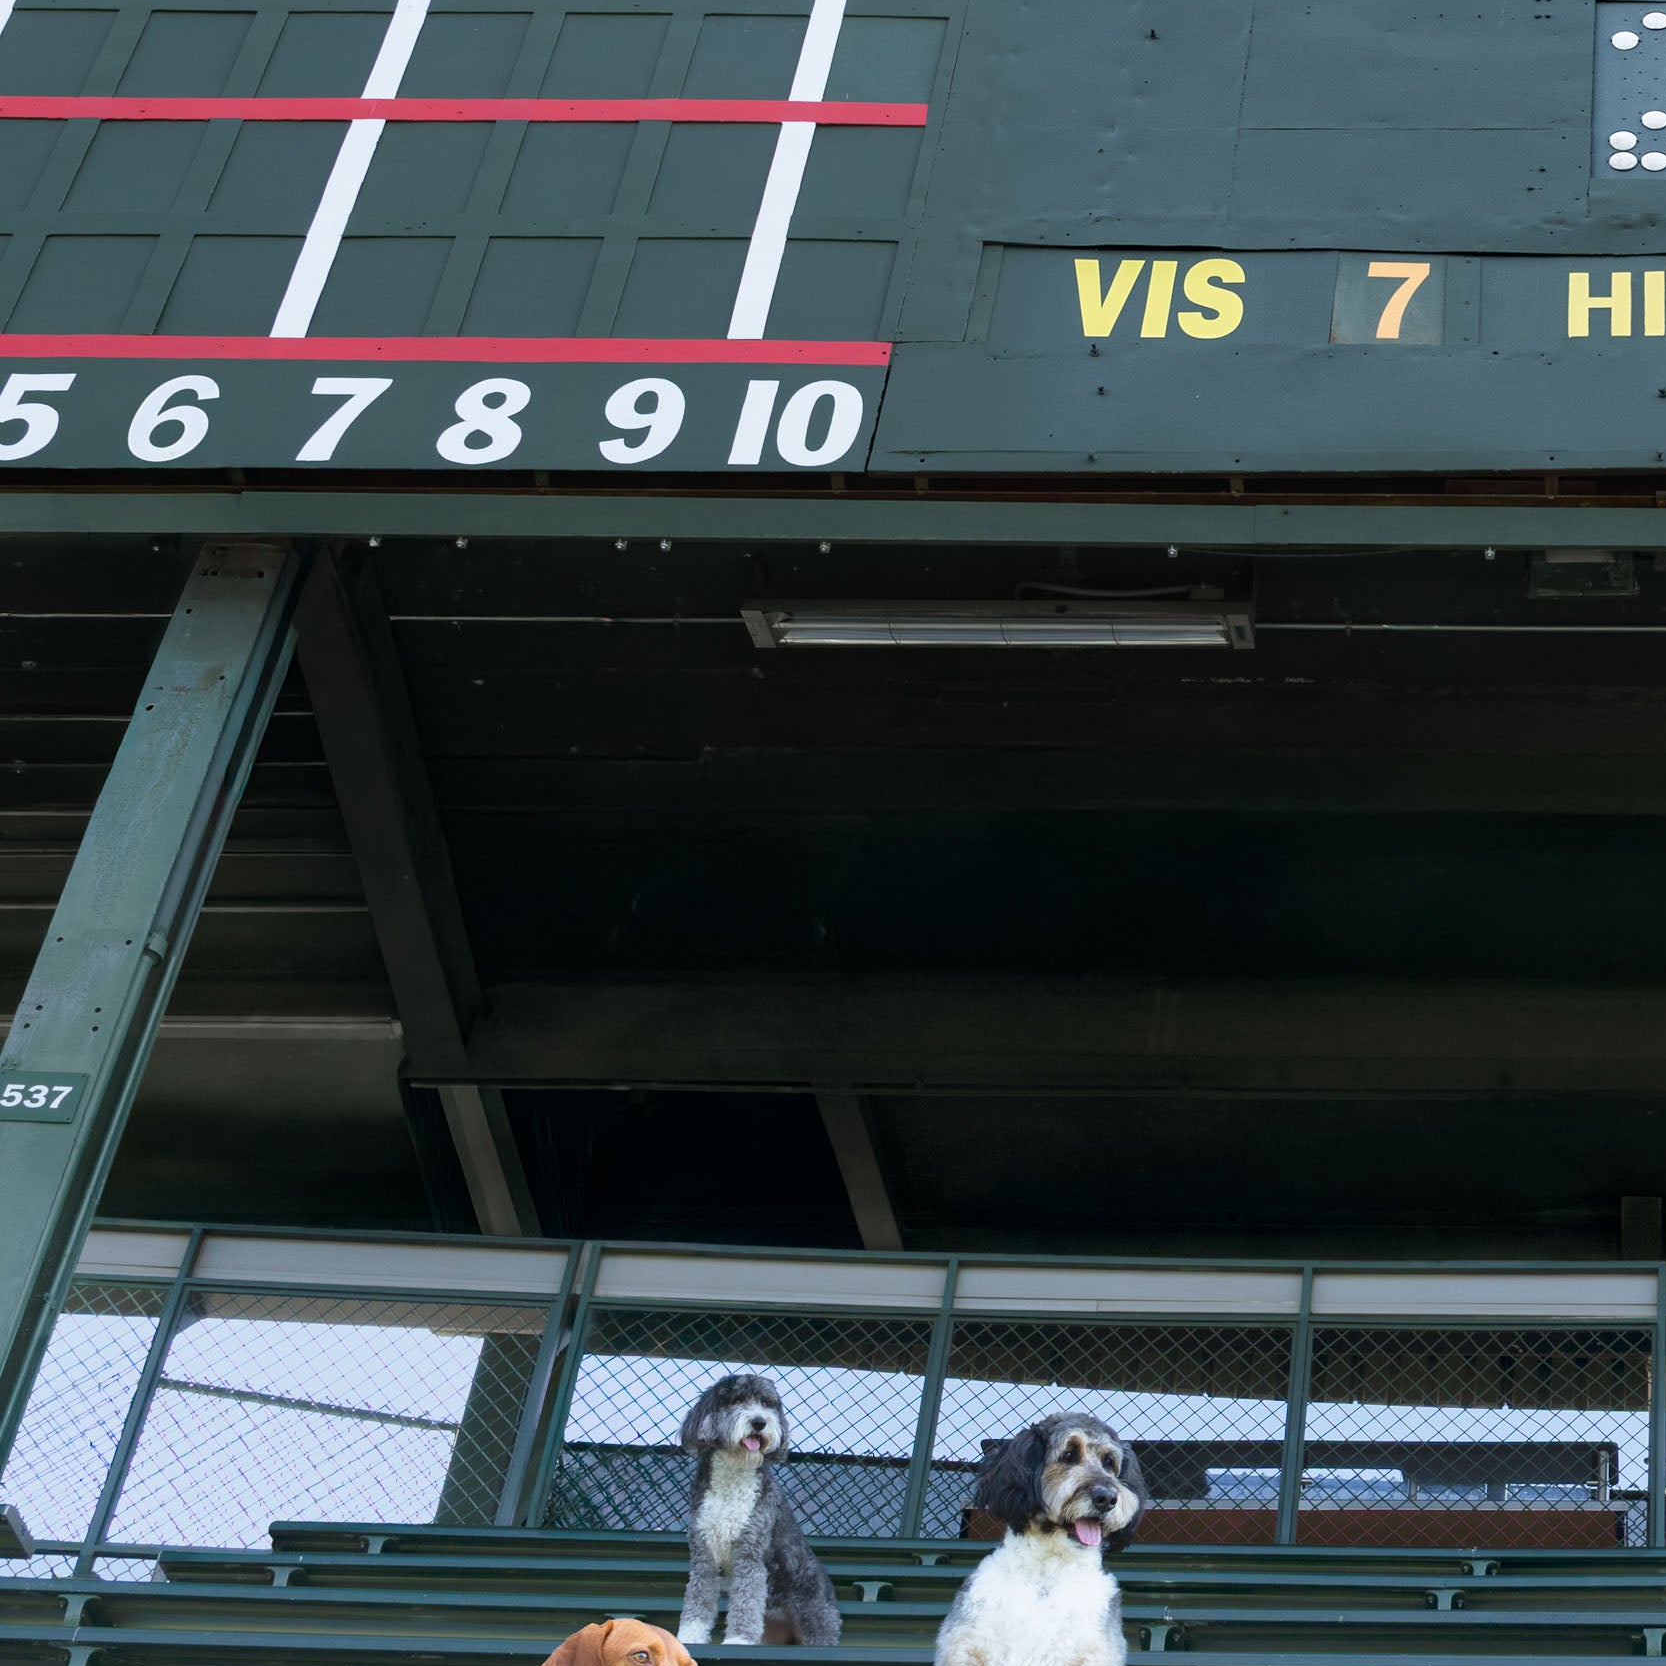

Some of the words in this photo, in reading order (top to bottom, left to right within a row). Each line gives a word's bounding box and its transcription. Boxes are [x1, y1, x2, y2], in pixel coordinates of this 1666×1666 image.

[1075, 259, 1245, 338] VIS
[1368, 262, 1430, 339] 7
[0, 374, 76, 460] 5
[128, 375, 219, 461] 6
[296, 378, 393, 461] 7
[437, 378, 530, 464] 8
[599, 378, 685, 463] 9
[728, 380, 863, 466] 10
[0, 1084, 73, 1109] 537
